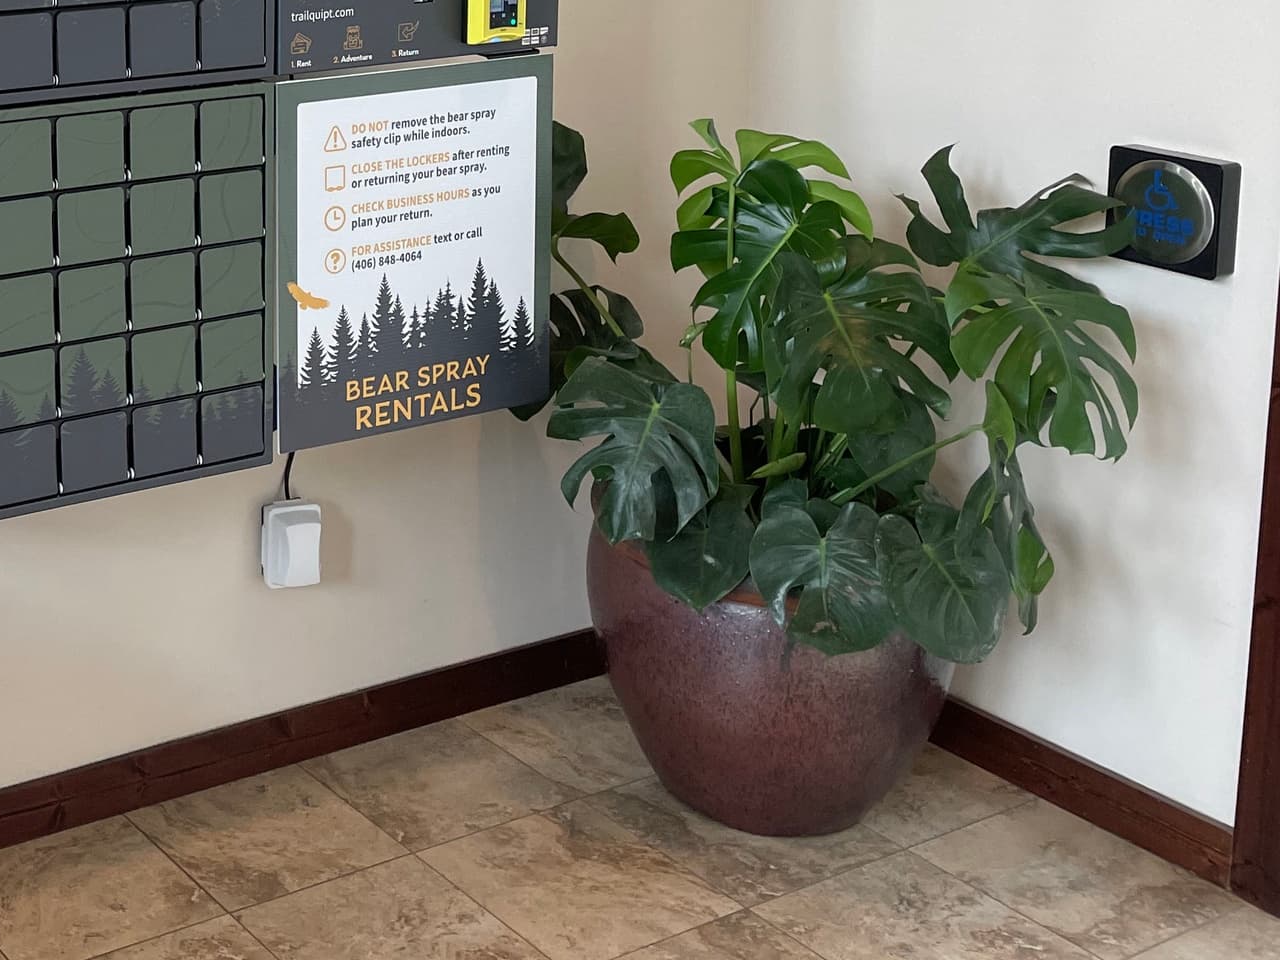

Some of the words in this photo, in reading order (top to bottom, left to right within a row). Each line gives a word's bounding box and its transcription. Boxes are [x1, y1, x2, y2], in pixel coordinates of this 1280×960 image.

[291, 7, 354, 22] trailquipt.com
[296, 60, 312, 68] Rent
[340, 53, 372, 63] Adventure
[398, 48, 419, 57] Return
[351, 123, 366, 134] DO
[368, 120, 390, 133] NOT
[391, 117, 427, 130] remove
[429, 113, 446, 125] the
[447, 111, 469, 123] bear
[470, 108, 496, 120] spray
[351, 136, 382, 149] safety
[384, 132, 401, 145] clip
[403, 130, 429, 141] while
[432, 125, 470, 138] indoors.
[351, 161, 383, 175] CLOSE
[385, 158, 404, 171] THE
[407, 152, 450, 167] LOCKERS
[452, 148, 475, 162] after
[476, 144, 510, 157] renting
[351, 179, 362, 189] or
[364, 171, 410, 186] returning
[412, 168, 434, 183] your
[436, 164, 458, 177] bear
[459, 162, 487, 174] spray.
[351, 200, 384, 215] CHECK
[387, 193, 434, 209] BUSINESS
[437, 188, 470, 202] HOURS
[471, 187, 481, 197] as
[483, 185, 500, 196] you
[351, 216, 373, 230] plan
[375, 212, 397, 227] your
[400, 208, 432, 221] return.
[351, 243, 372, 257] FOR
[373, 235, 432, 253] ASSISTANCE
[433, 233, 452, 244] text
[453, 231, 464, 240] or
[466, 227, 483, 239] call
[351, 255, 376, 272] (406)
[378, 250, 422, 267] 848-4064
[346, 370, 409, 402] BEAR
[417, 354, 490, 386] SPRAY
[355, 383, 481, 431] RENTALS
